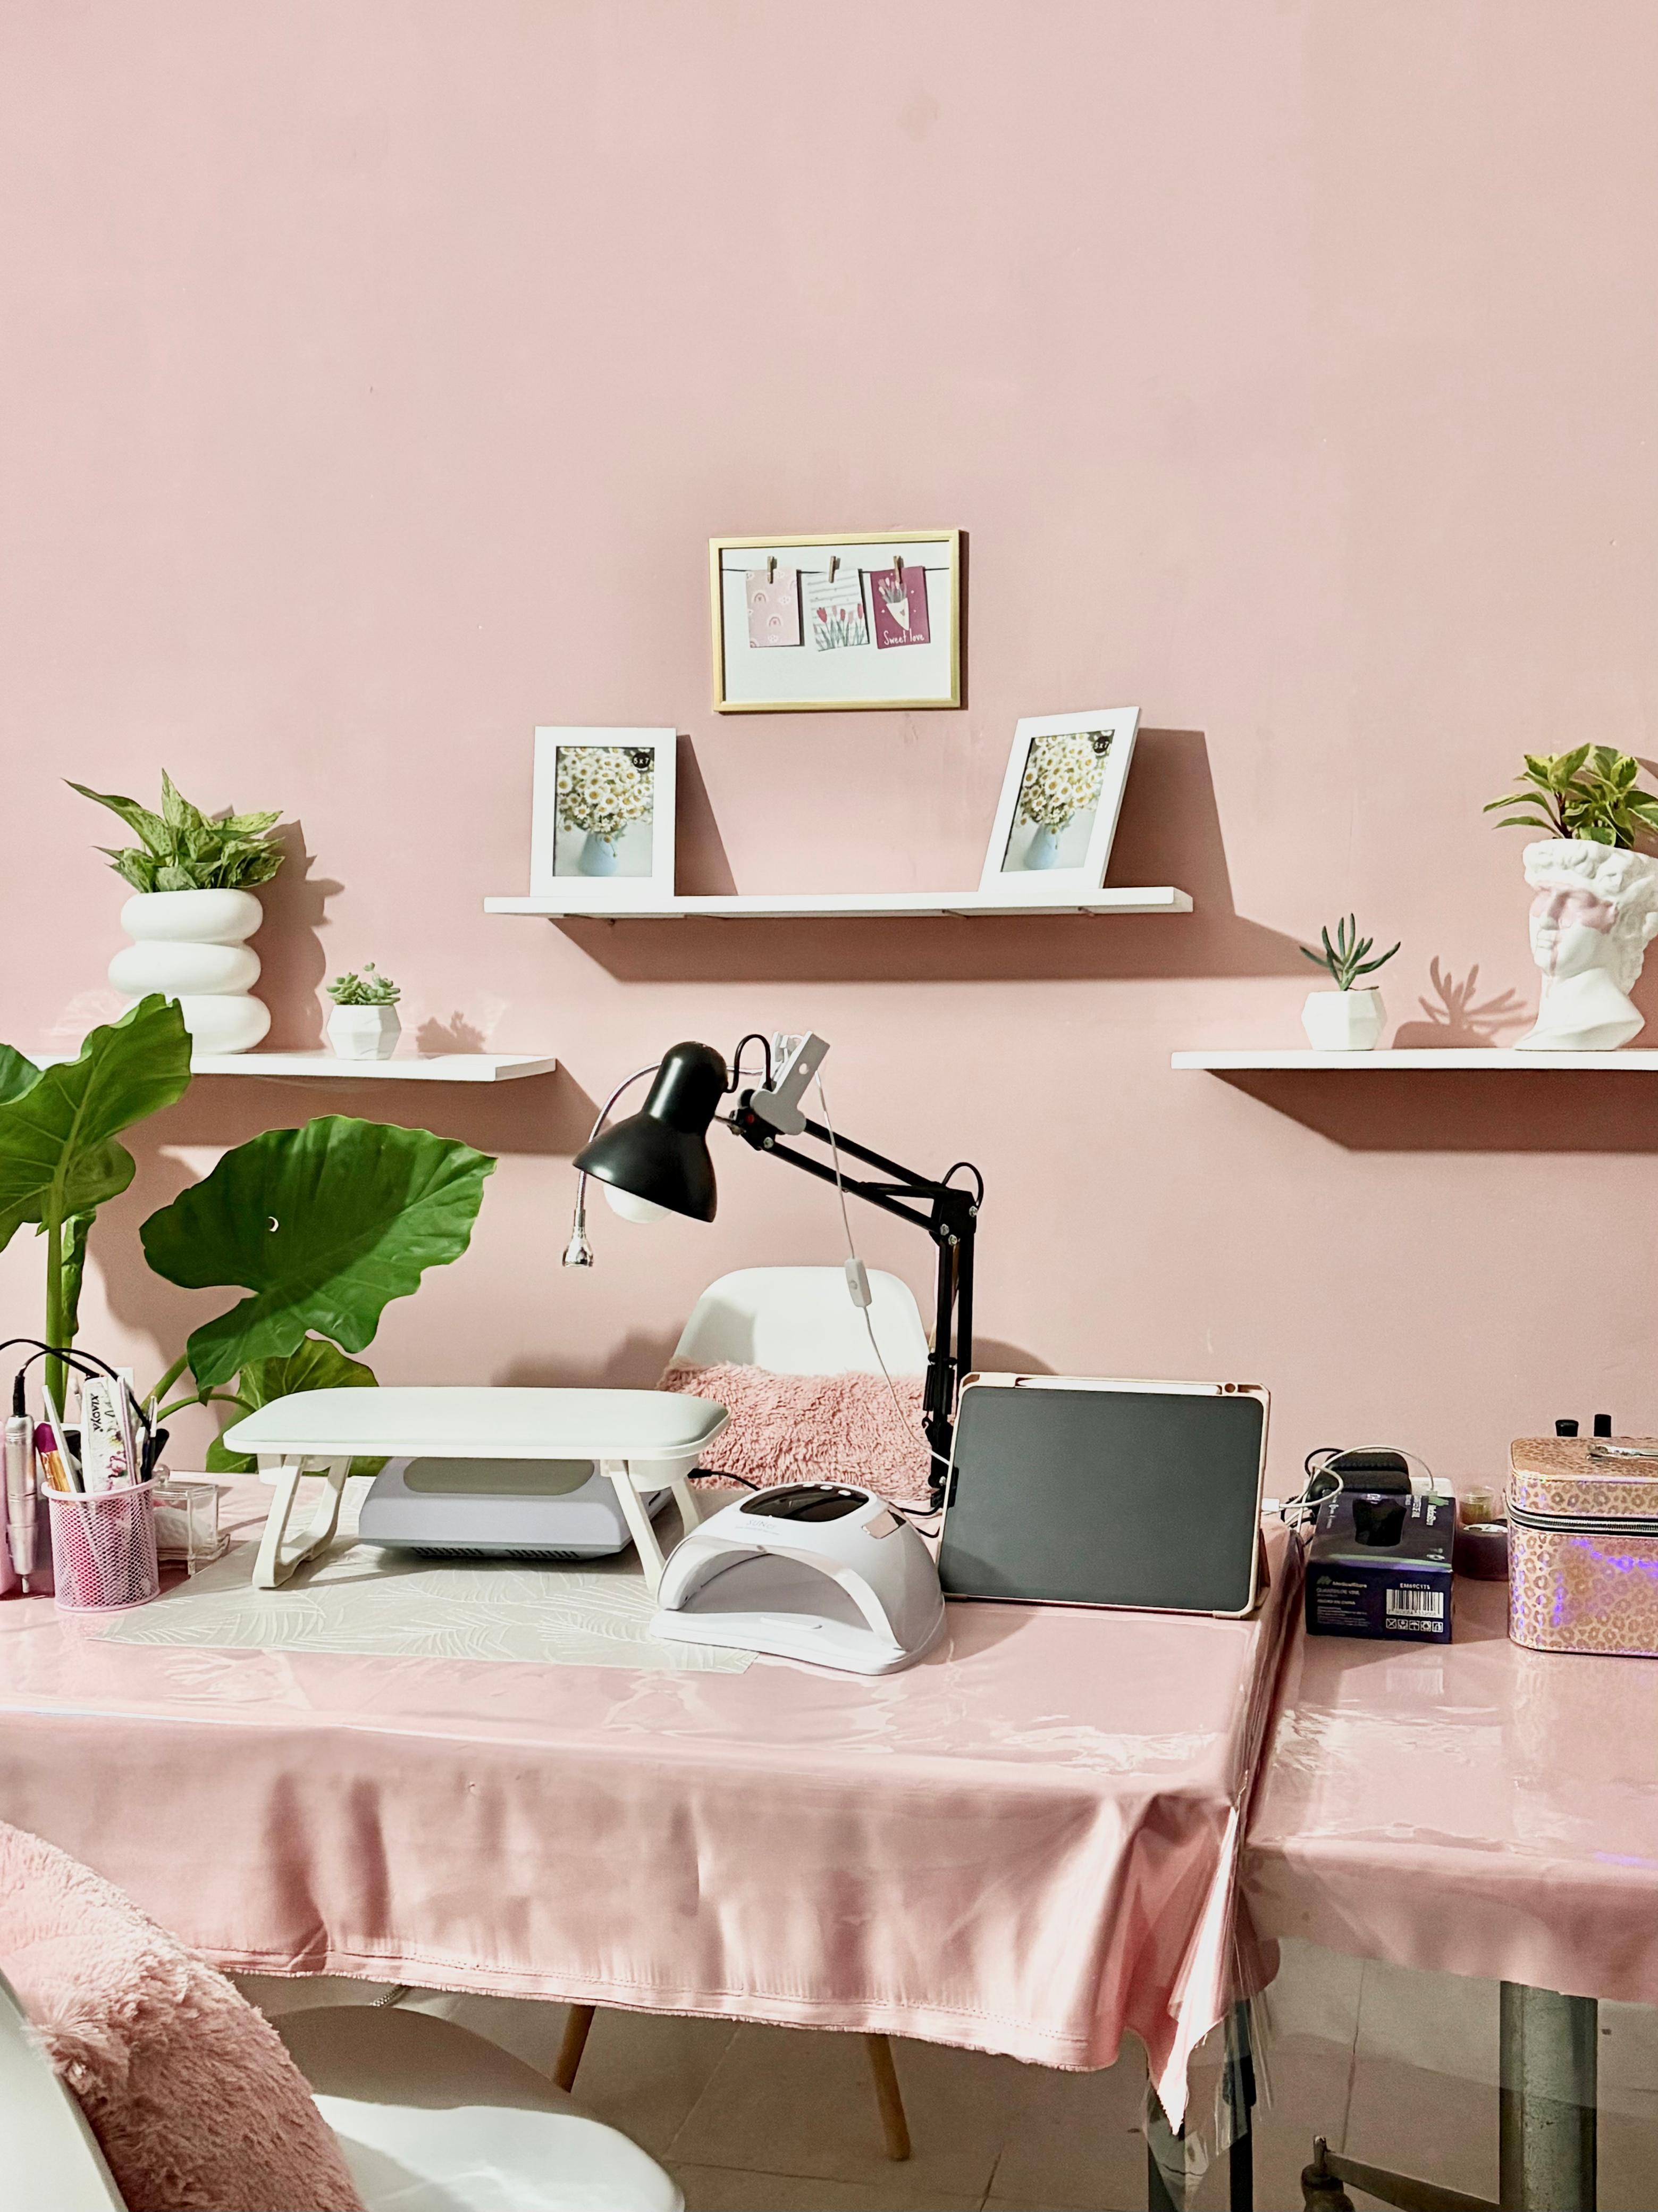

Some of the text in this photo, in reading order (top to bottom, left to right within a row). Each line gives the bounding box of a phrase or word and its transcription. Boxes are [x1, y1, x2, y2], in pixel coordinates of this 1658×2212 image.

[883, 628, 924, 646] Sweet love
[90, 1393, 102, 1432] XIAOYA
